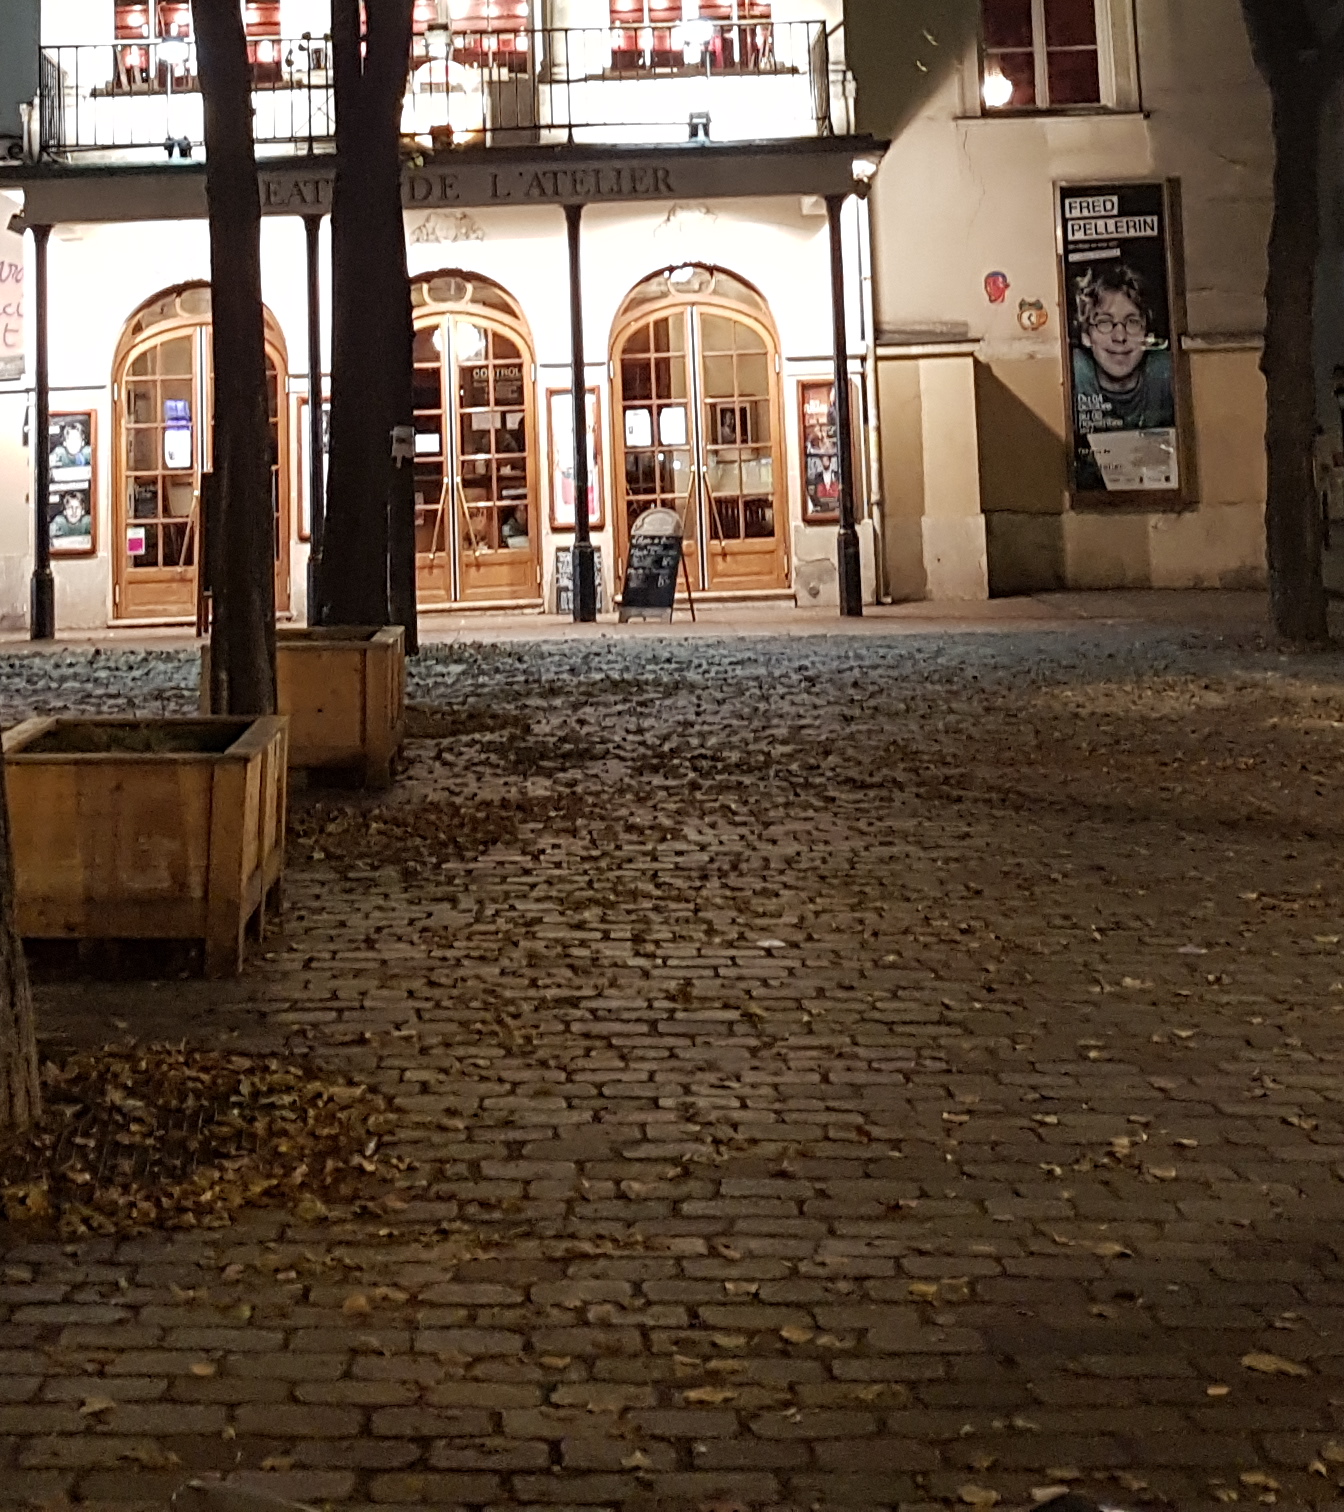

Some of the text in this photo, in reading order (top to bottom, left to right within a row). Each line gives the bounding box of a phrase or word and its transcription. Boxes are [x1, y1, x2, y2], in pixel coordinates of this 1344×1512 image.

[408, 174, 460, 202] DE
[489, 167, 675, 198] L'ATELIER
[1068, 199, 1114, 215] FRED
[1071, 218, 1155, 237] PELLERIN
